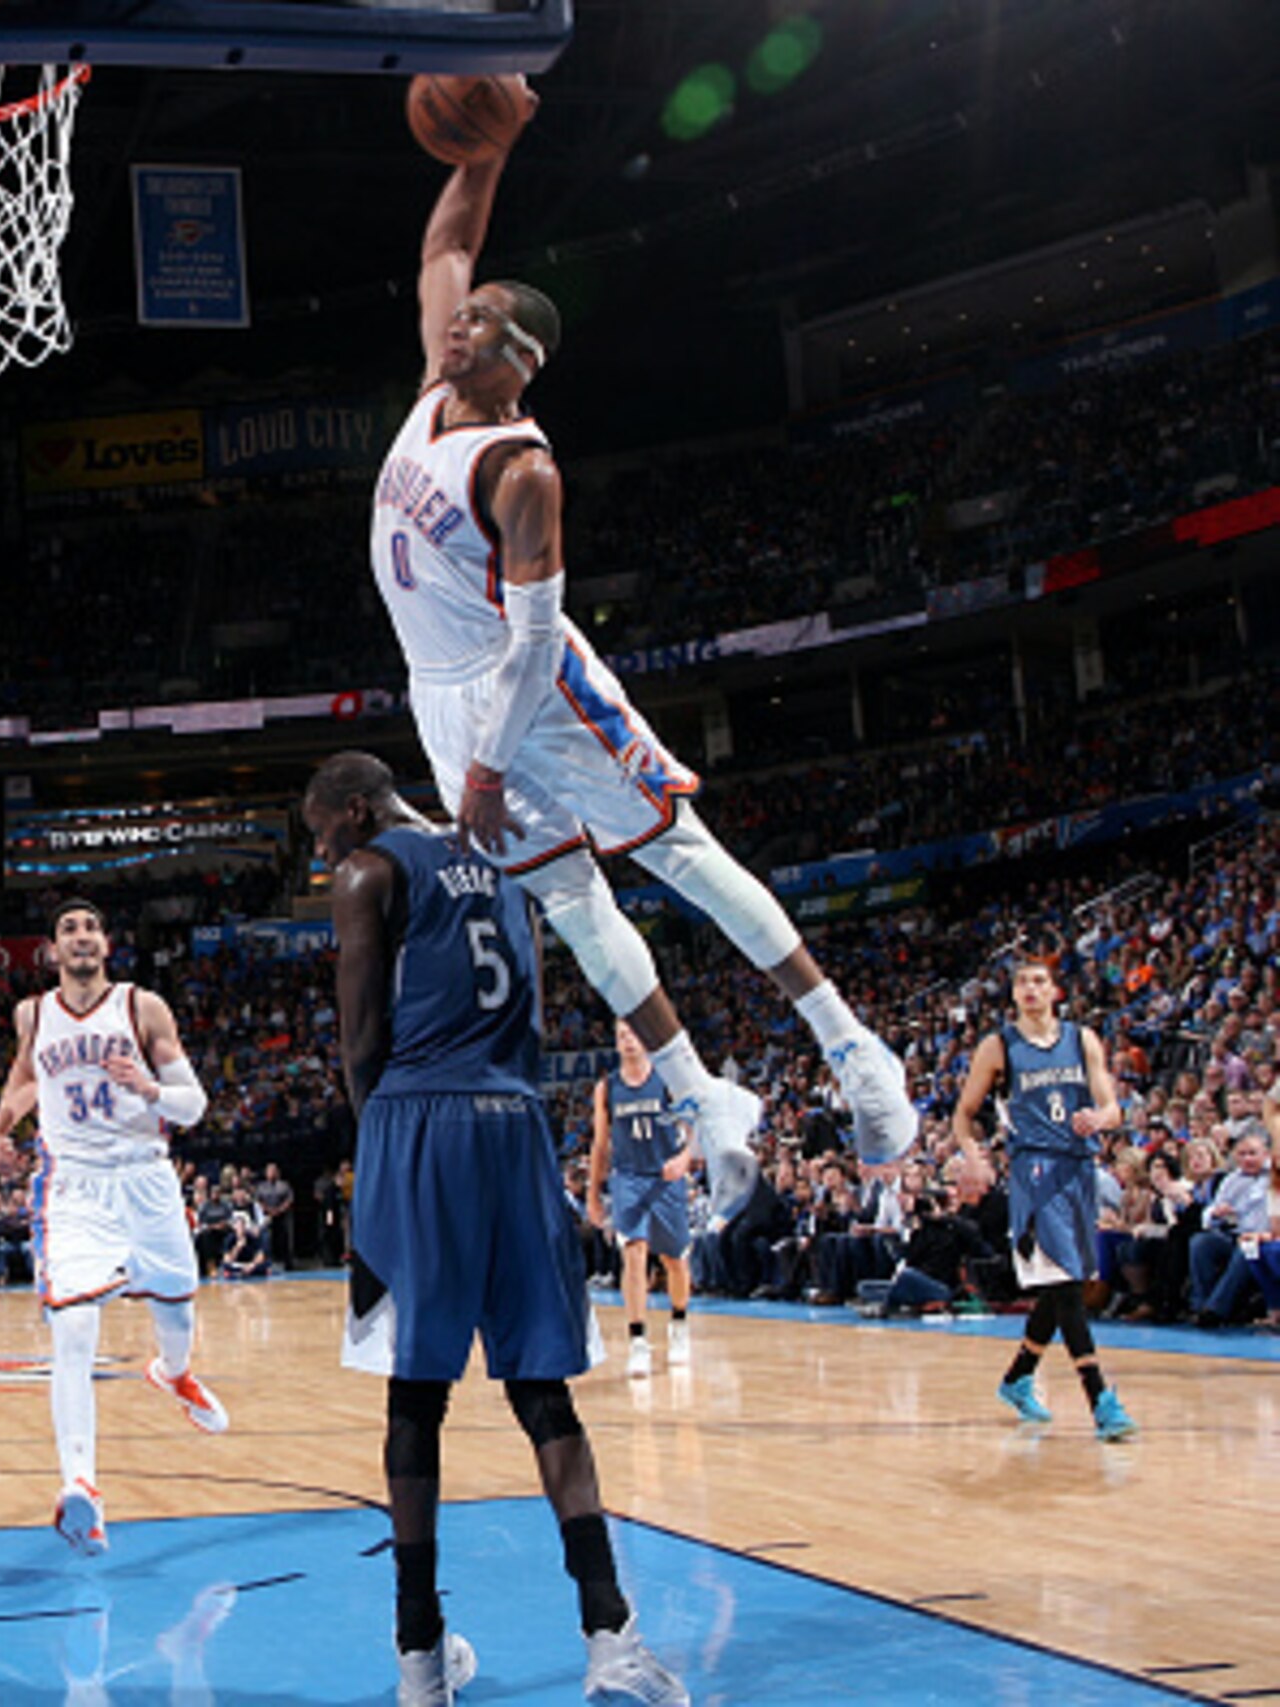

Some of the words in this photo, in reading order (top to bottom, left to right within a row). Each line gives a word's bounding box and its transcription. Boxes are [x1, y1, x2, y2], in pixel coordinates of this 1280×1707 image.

[217, 408, 297, 467] LOUD
[306, 406, 374, 454] CITY
[391, 530, 417, 591] 0
[464, 918, 511, 1011] 5
[64, 1081, 115, 1123] 34
